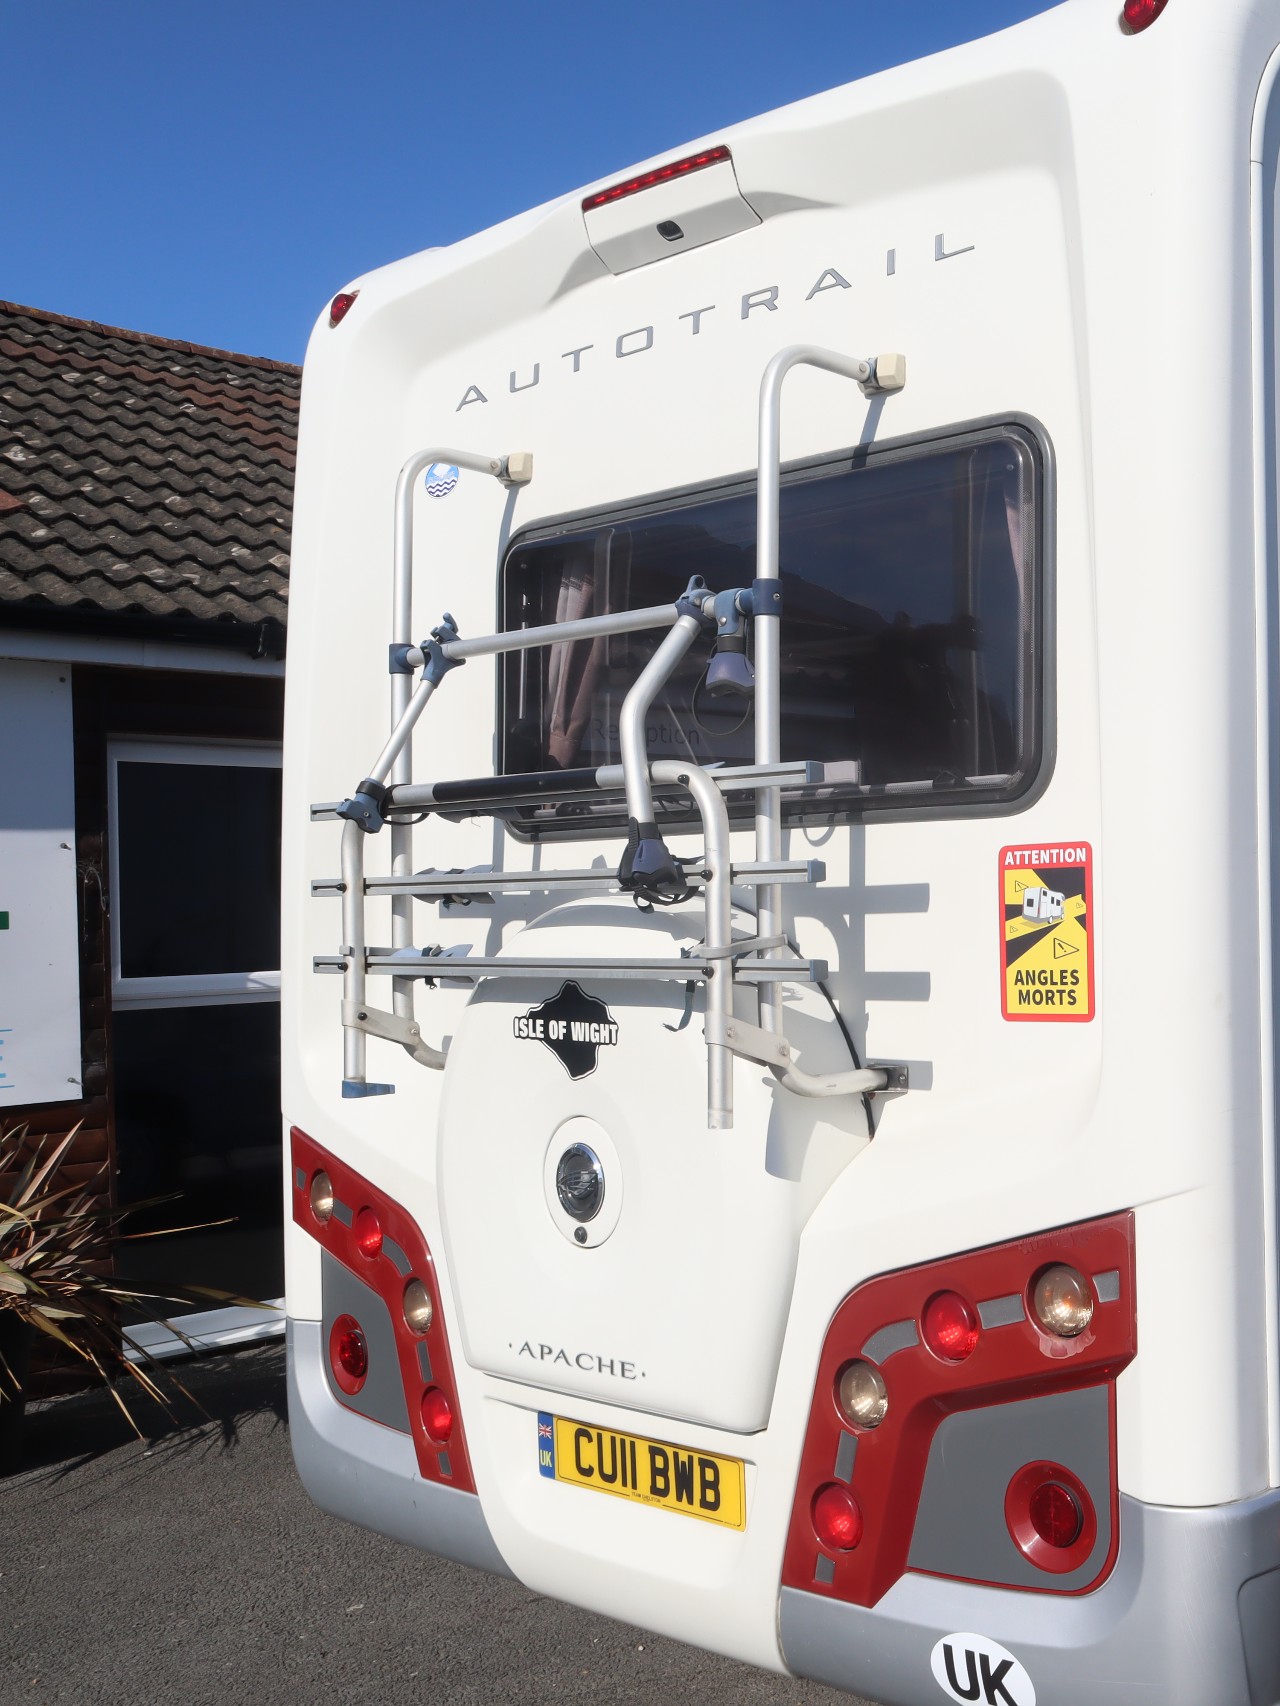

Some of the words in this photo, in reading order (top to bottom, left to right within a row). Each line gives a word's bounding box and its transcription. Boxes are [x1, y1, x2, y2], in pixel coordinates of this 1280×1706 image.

[455, 232, 976, 412] AUTOTRAIL
[592, 719, 700, 747] Reption
[1004, 847, 1087, 866] ATTENTION
[1014, 969, 1080, 986] ANGLES
[1018, 989, 1077, 1006] MORTS
[514, 1018, 545, 1038] ISLE
[548, 1020, 567, 1040] OF
[570, 1021, 618, 1044] WIGHT
[518, 1341, 637, 1380] APACHE
[539, 1449, 553, 1468] UK
[574, 1427, 638, 1491] CU11
[648, 1444, 721, 1512] BWB
[942, 1643, 1019, 1706] UK
